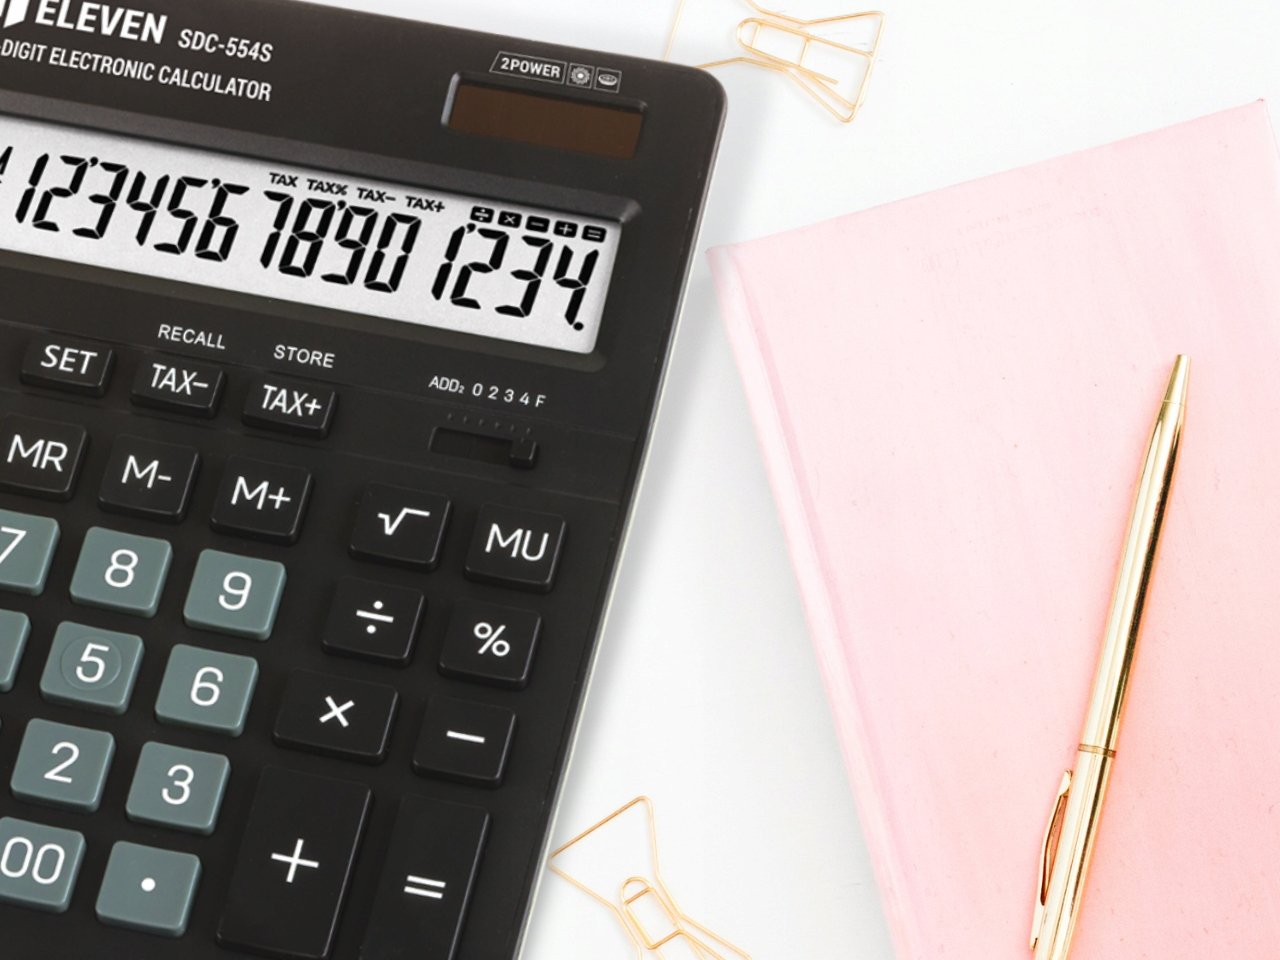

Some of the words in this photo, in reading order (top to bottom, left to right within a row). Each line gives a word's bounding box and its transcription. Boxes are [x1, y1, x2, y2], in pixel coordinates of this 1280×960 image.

[178, 29, 272, 62] SDC-554S
[0, 38, 48, 63] DIGIT
[49, 47, 155, 80] ELECTRONIC
[159, 66, 271, 101] CALCULATOR
[500, 56, 561, 79] 2POWER
[269, 172, 299, 188] TAX
[157, 323, 226, 350] RECALL
[41, 345, 97, 374] SET
[273, 344, 335, 369] STORE
[152, 364, 208, 395] TAX-
[471, 382, 484, 397] 0
[487, 385, 500, 401] 2
[503, 388, 515, 403] 3
[518, 391, 530, 406] 4
[534, 394, 547, 408] F
[263, 385, 321, 416] TAX+
[7, 435, 67, 471] MR
[122, 455, 171, 488] M-
[232, 476, 290, 509] M+
[0, 527, 26, 563] 7
[486, 524, 548, 561] MU
[105, 550, 138, 587] 8
[219, 572, 251, 610] 9
[76, 643, 109, 682] 5
[191, 667, 223, 706] 6
[44, 742, 79, 783] 2
[162, 765, 194, 804] 3
[1, 837, 64, 884] 00
